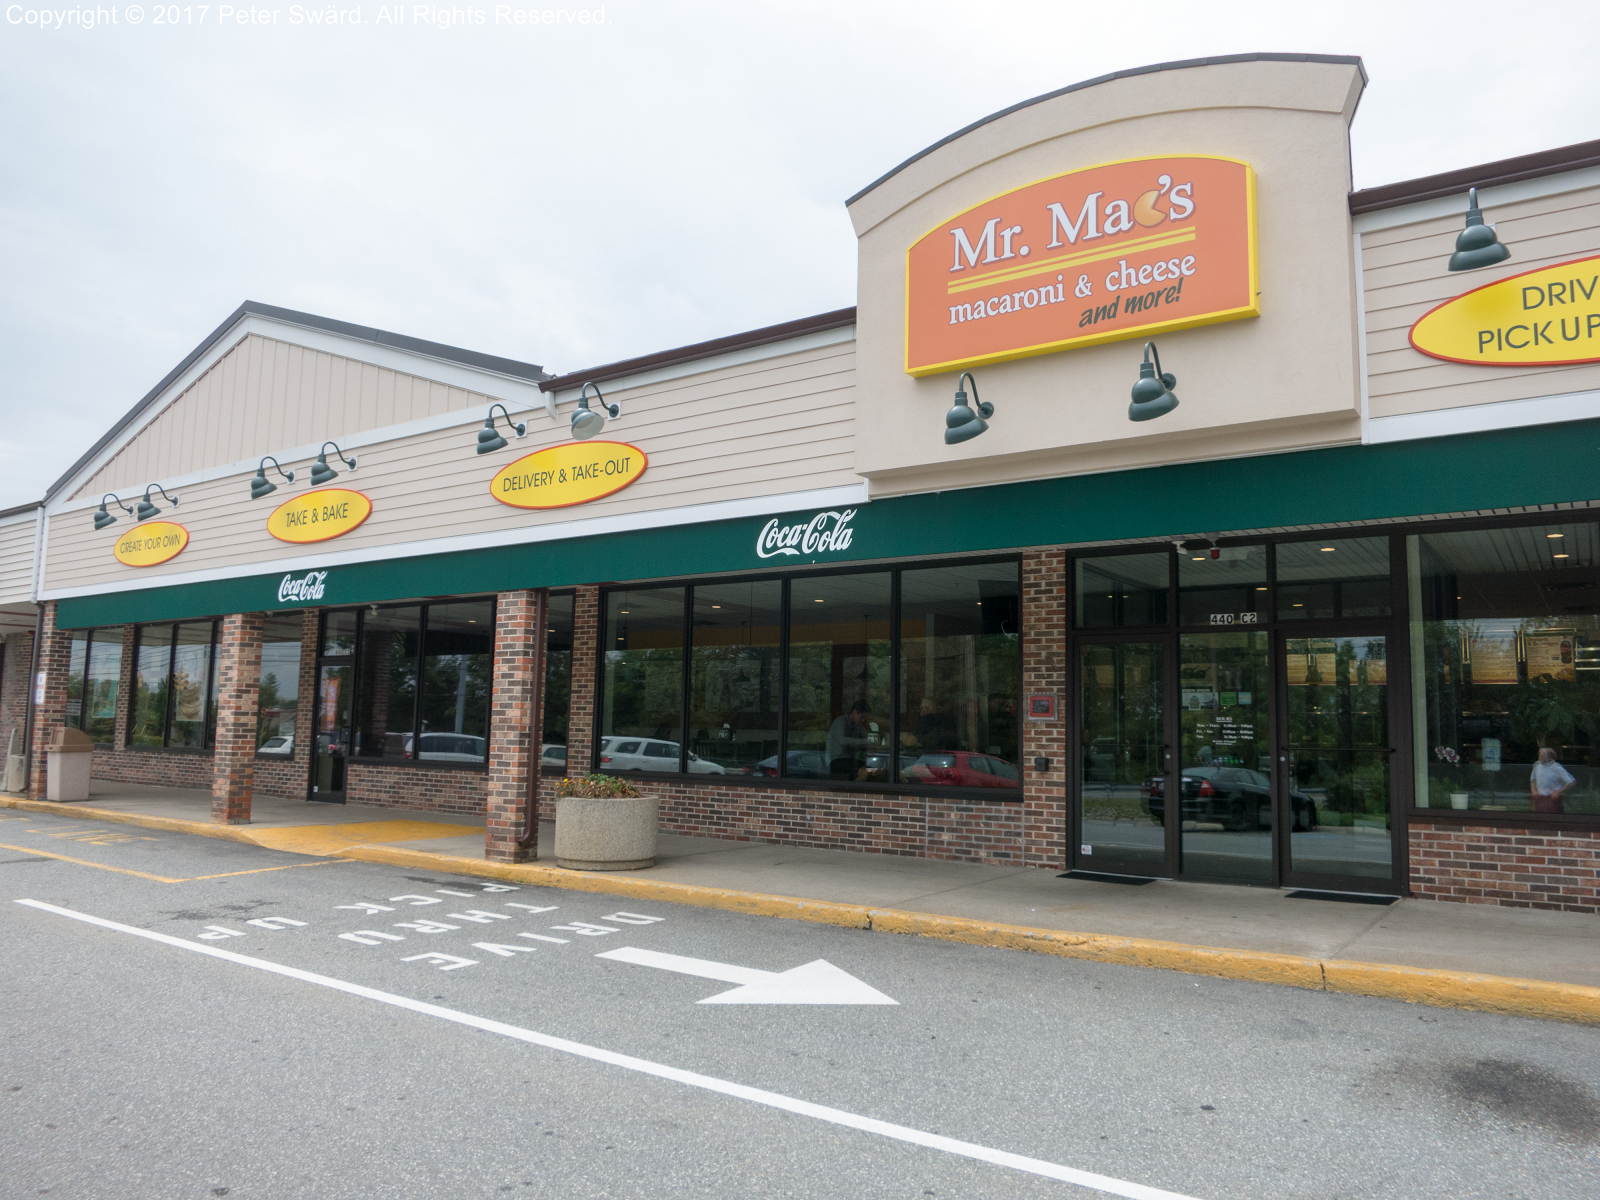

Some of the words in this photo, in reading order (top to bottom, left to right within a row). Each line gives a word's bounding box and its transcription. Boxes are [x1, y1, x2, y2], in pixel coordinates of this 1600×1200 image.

[950, 218, 1031, 272] Mr.
[1046, 174, 1196, 249] Mac's
[949, 274, 1065, 324] macaroni
[1074, 274, 1093, 298] &
[1105, 255, 1197, 292] cheese
[1079, 296, 1118, 328] and
[1124, 277, 1184, 314] more!
[503, 470, 555, 492] DELIVERY
[558, 469, 568, 484] &
[571, 457, 630, 481] TAKE-OUT
[286, 509, 308, 528] TAKE
[311, 508, 319, 523] &
[322, 502, 348, 521] BAKE
[120, 540, 142, 554] CREATE
[143, 537, 161, 550] YOUR
[162, 534, 181, 548] OWN
[757, 508, 858, 559] Coca-Cola
[277, 570, 328, 602] Coca-Cola
[1211, 614, 1234, 625] 440
[1241, 613, 1256, 624] C2
[333, 882, 521, 915] PICK
[197, 916, 309, 940] UP
[337, 902, 561, 946] THRU
[400, 911, 667, 972] DRIVE
